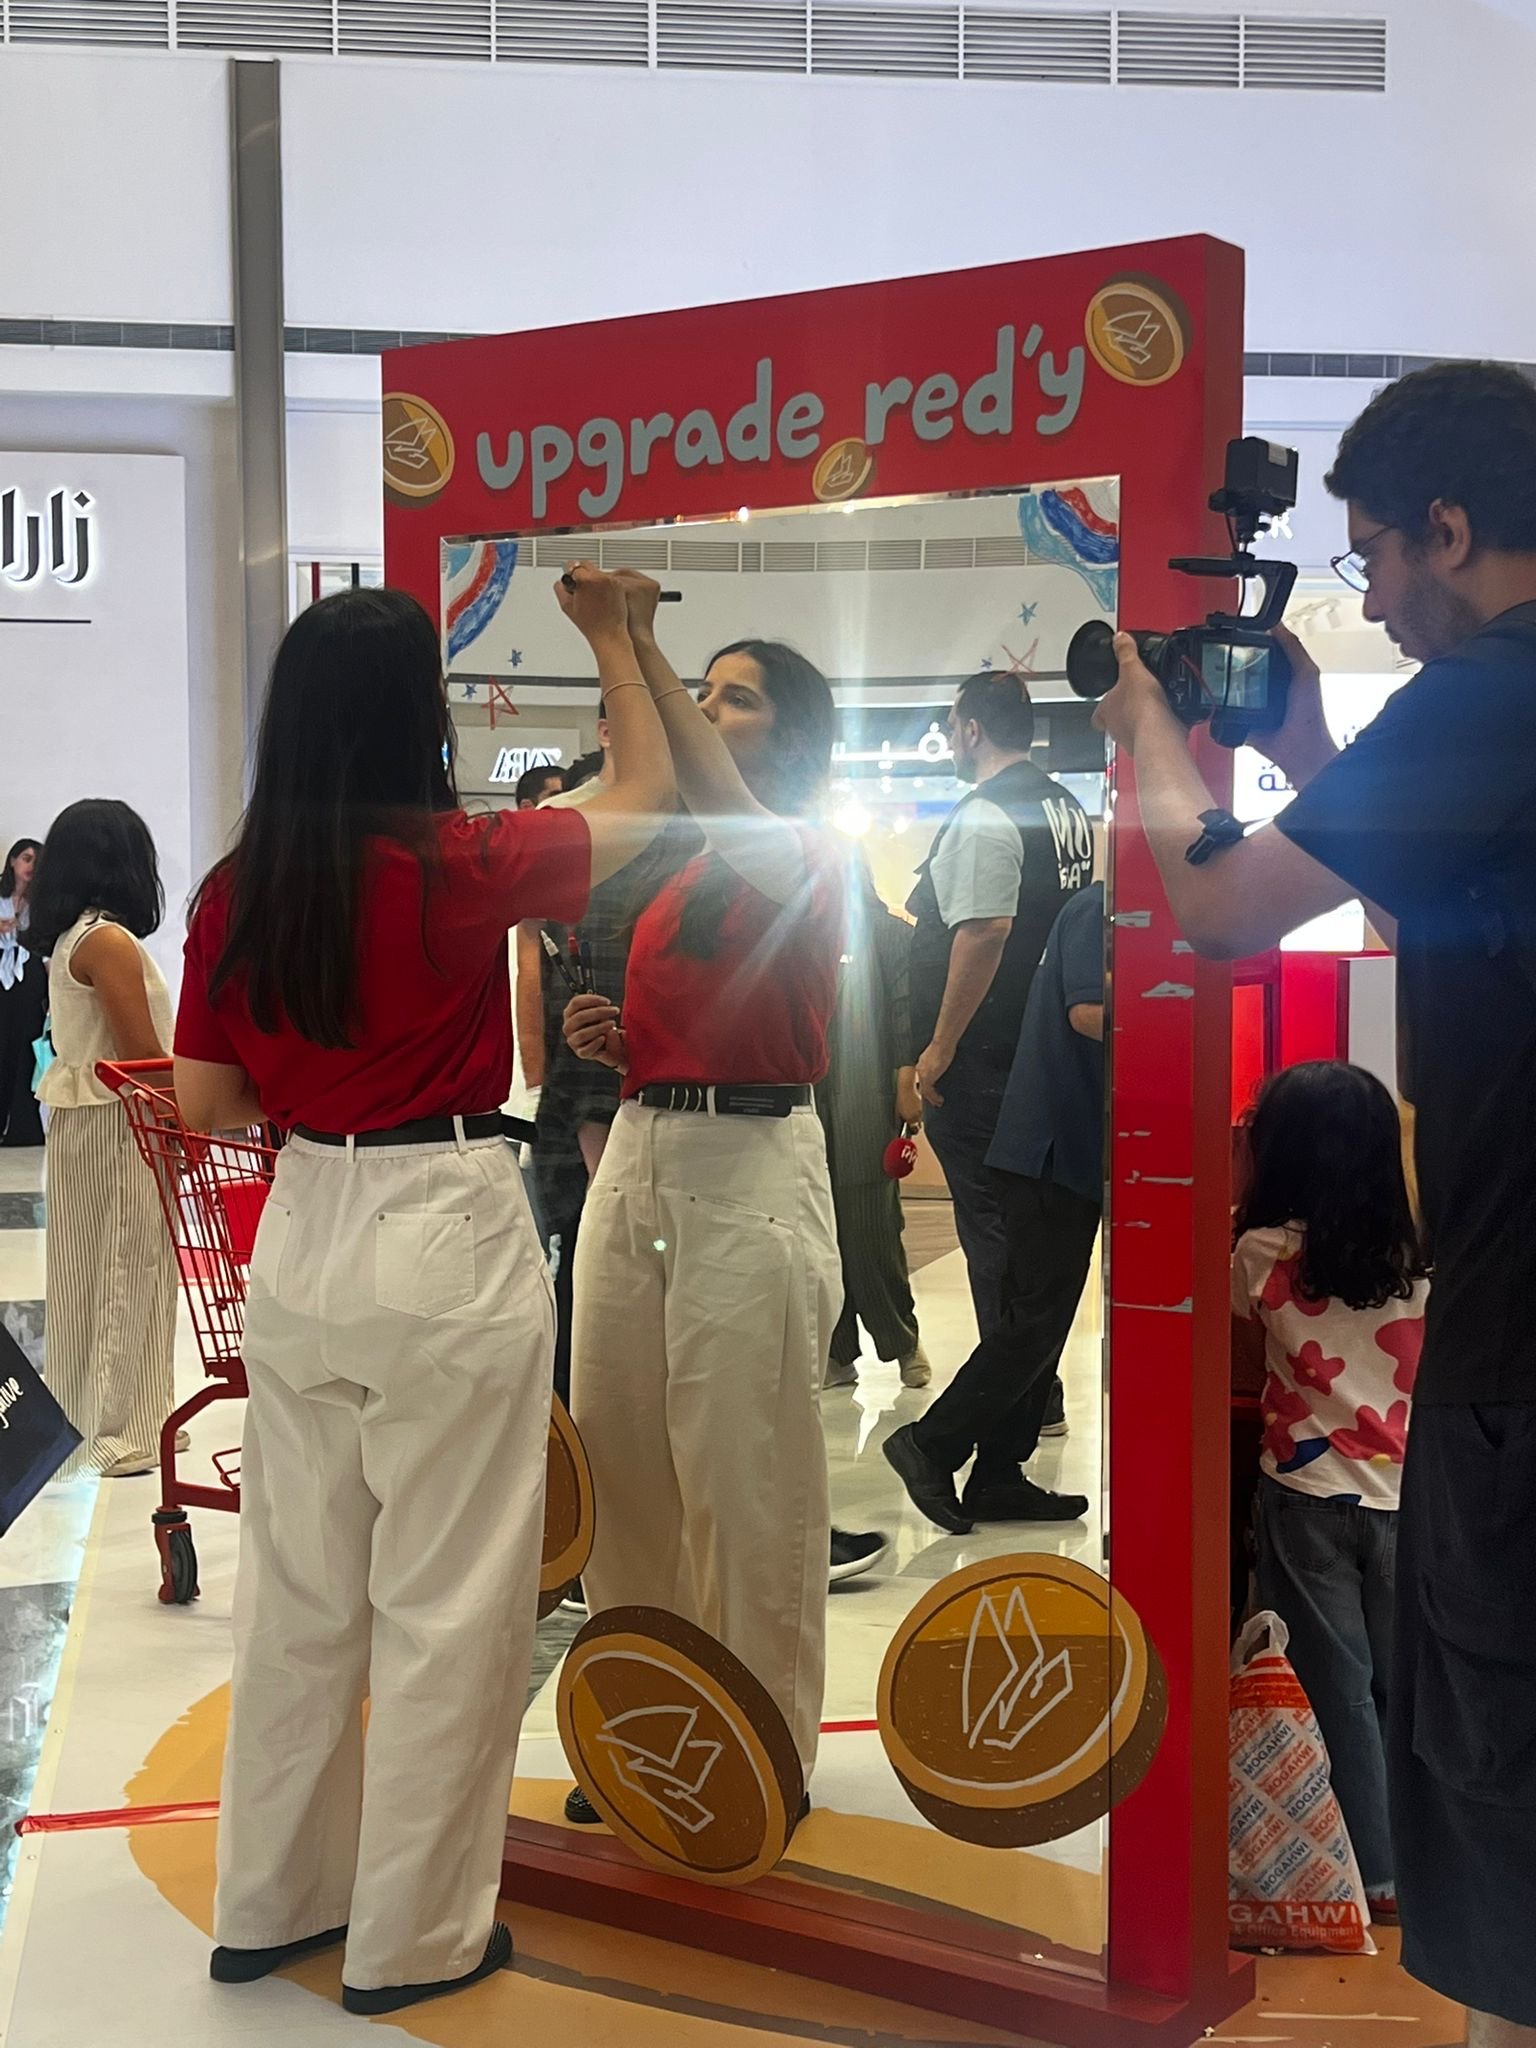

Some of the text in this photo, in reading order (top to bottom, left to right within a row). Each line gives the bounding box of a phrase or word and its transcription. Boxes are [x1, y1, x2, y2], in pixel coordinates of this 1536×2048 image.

[476, 323, 1086, 519] upgrade red'y
[1, 488, 91, 584] زارا
[1242, 1724, 1292, 1777] MOGAHWI
[1264, 1744, 1314, 1797] MOGAHWI
[1259, 1840, 1310, 1892] MOGAHWI
[1228, 1904, 1359, 1924] GAHWI
